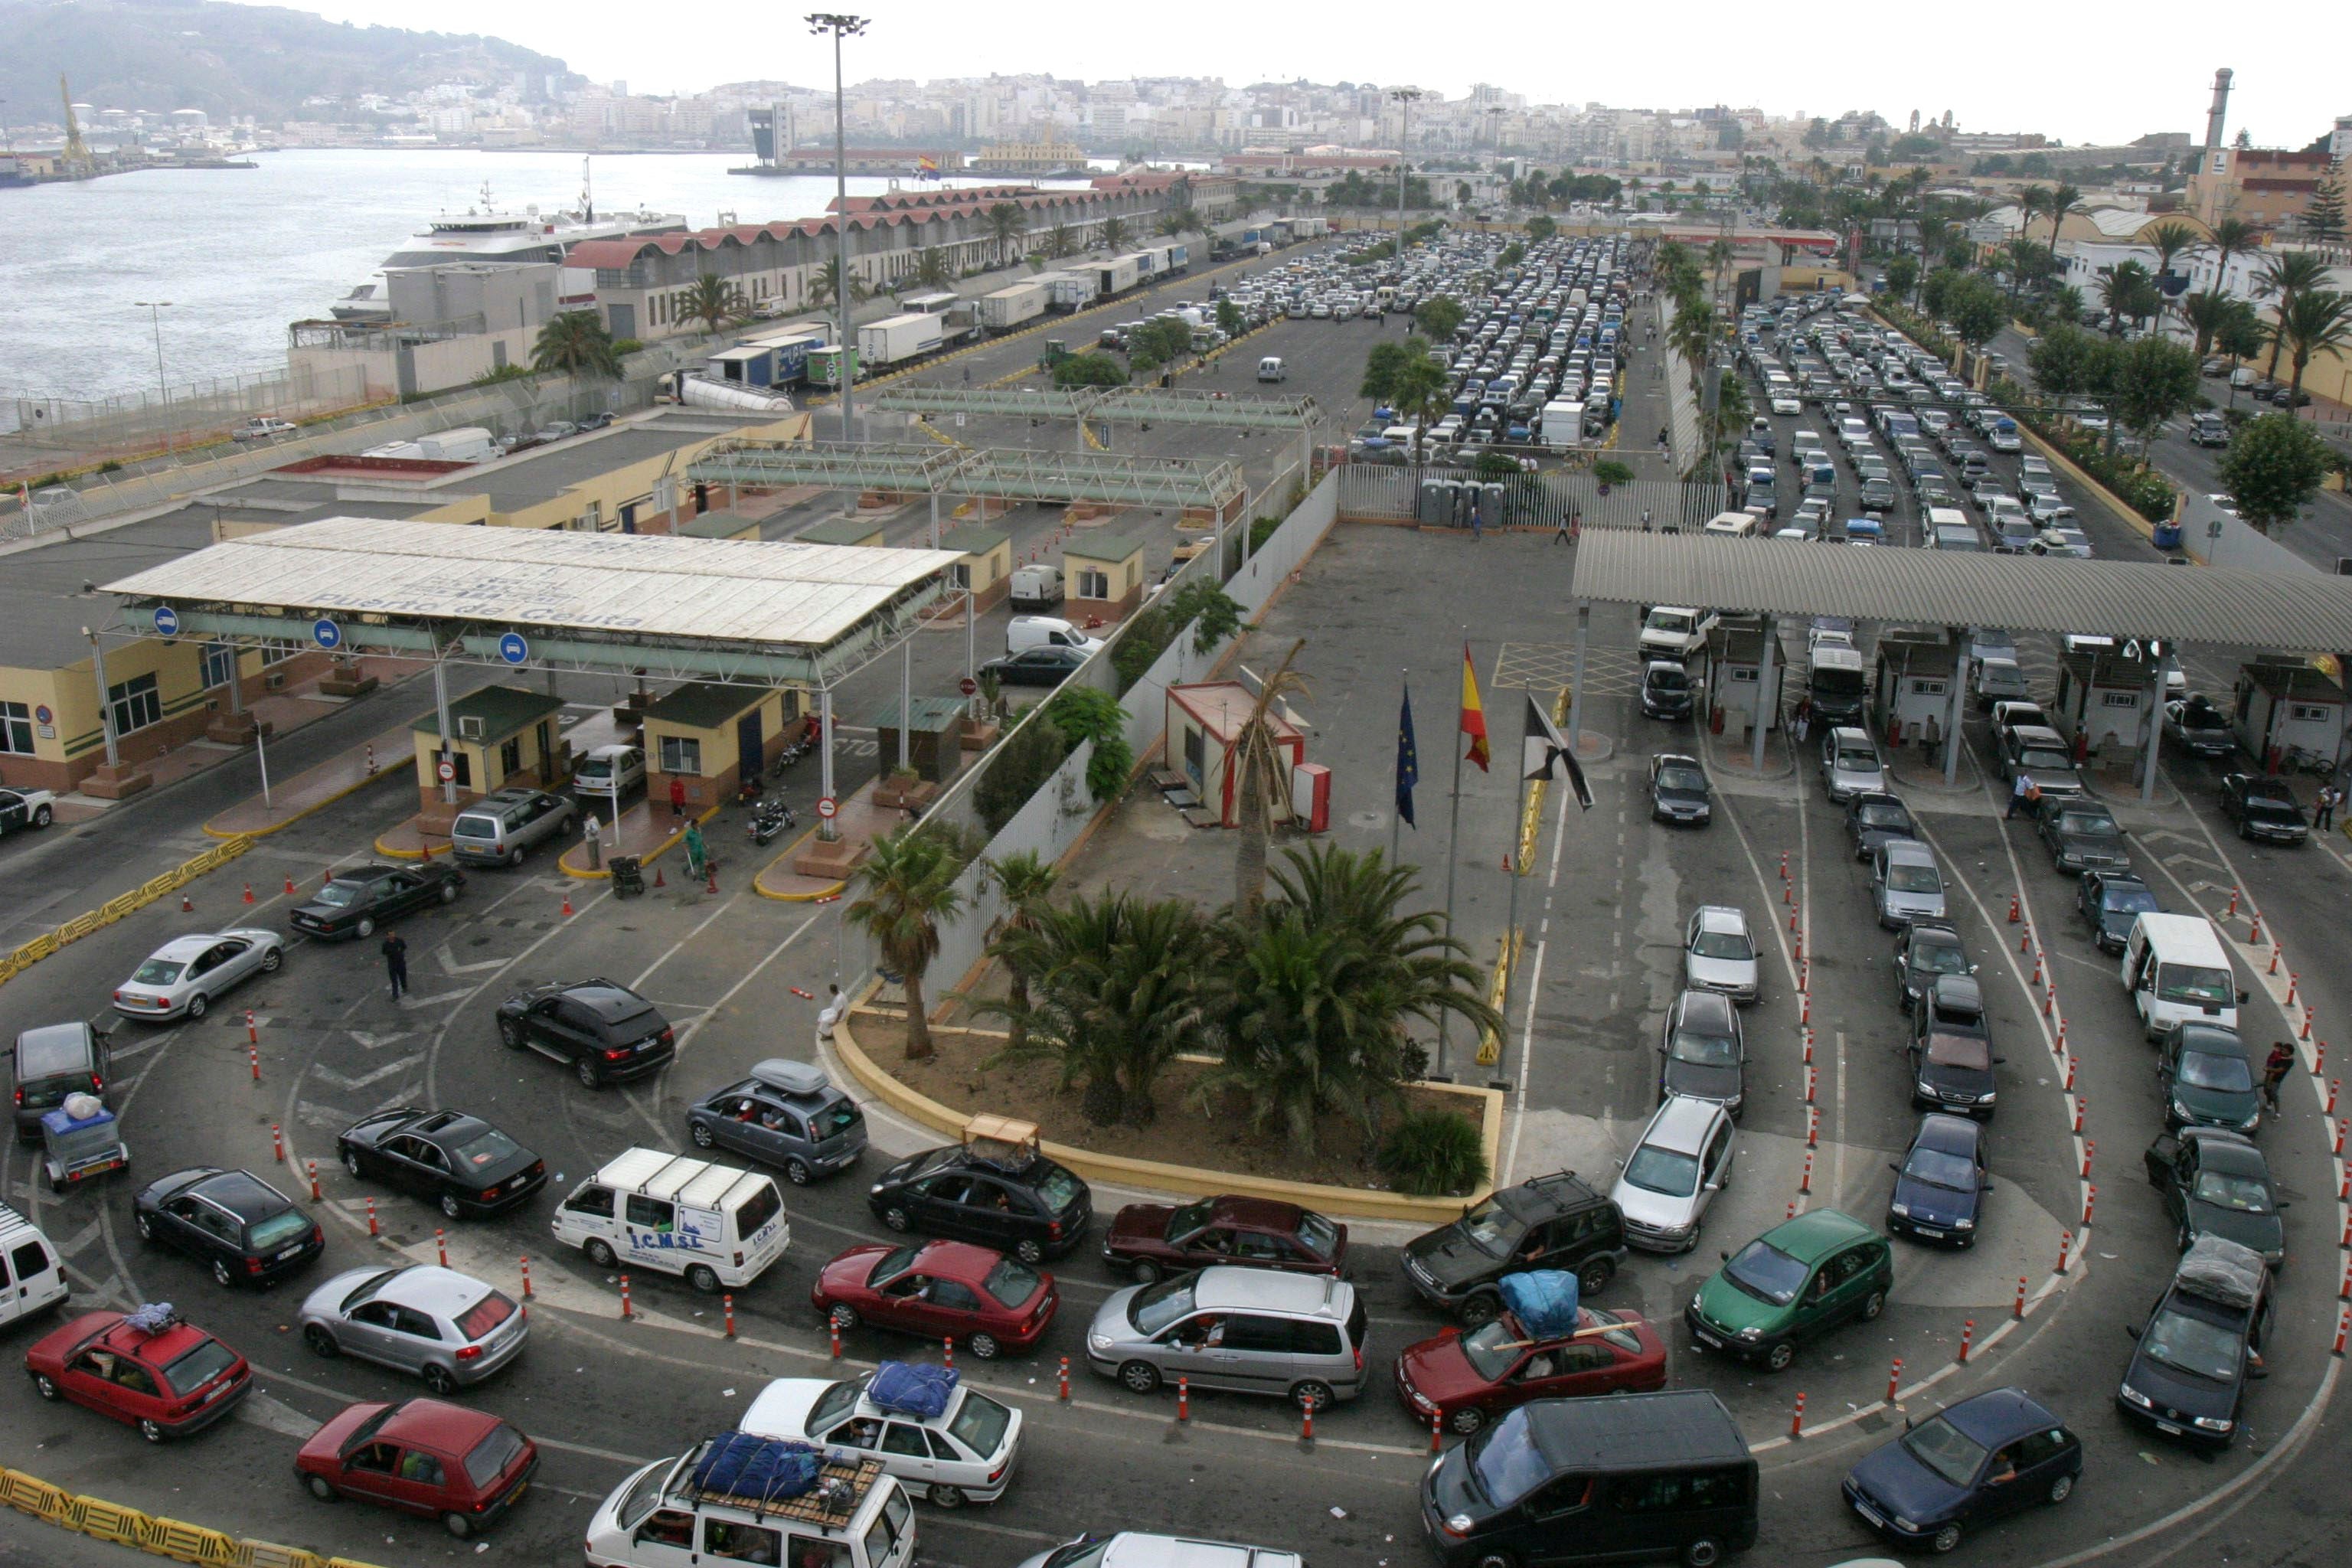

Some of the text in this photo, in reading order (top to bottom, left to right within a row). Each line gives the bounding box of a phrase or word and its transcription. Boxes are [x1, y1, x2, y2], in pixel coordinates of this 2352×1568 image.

[309, 593, 642, 626] Puerto de Ceuta
[832, 738, 878, 756] STO
